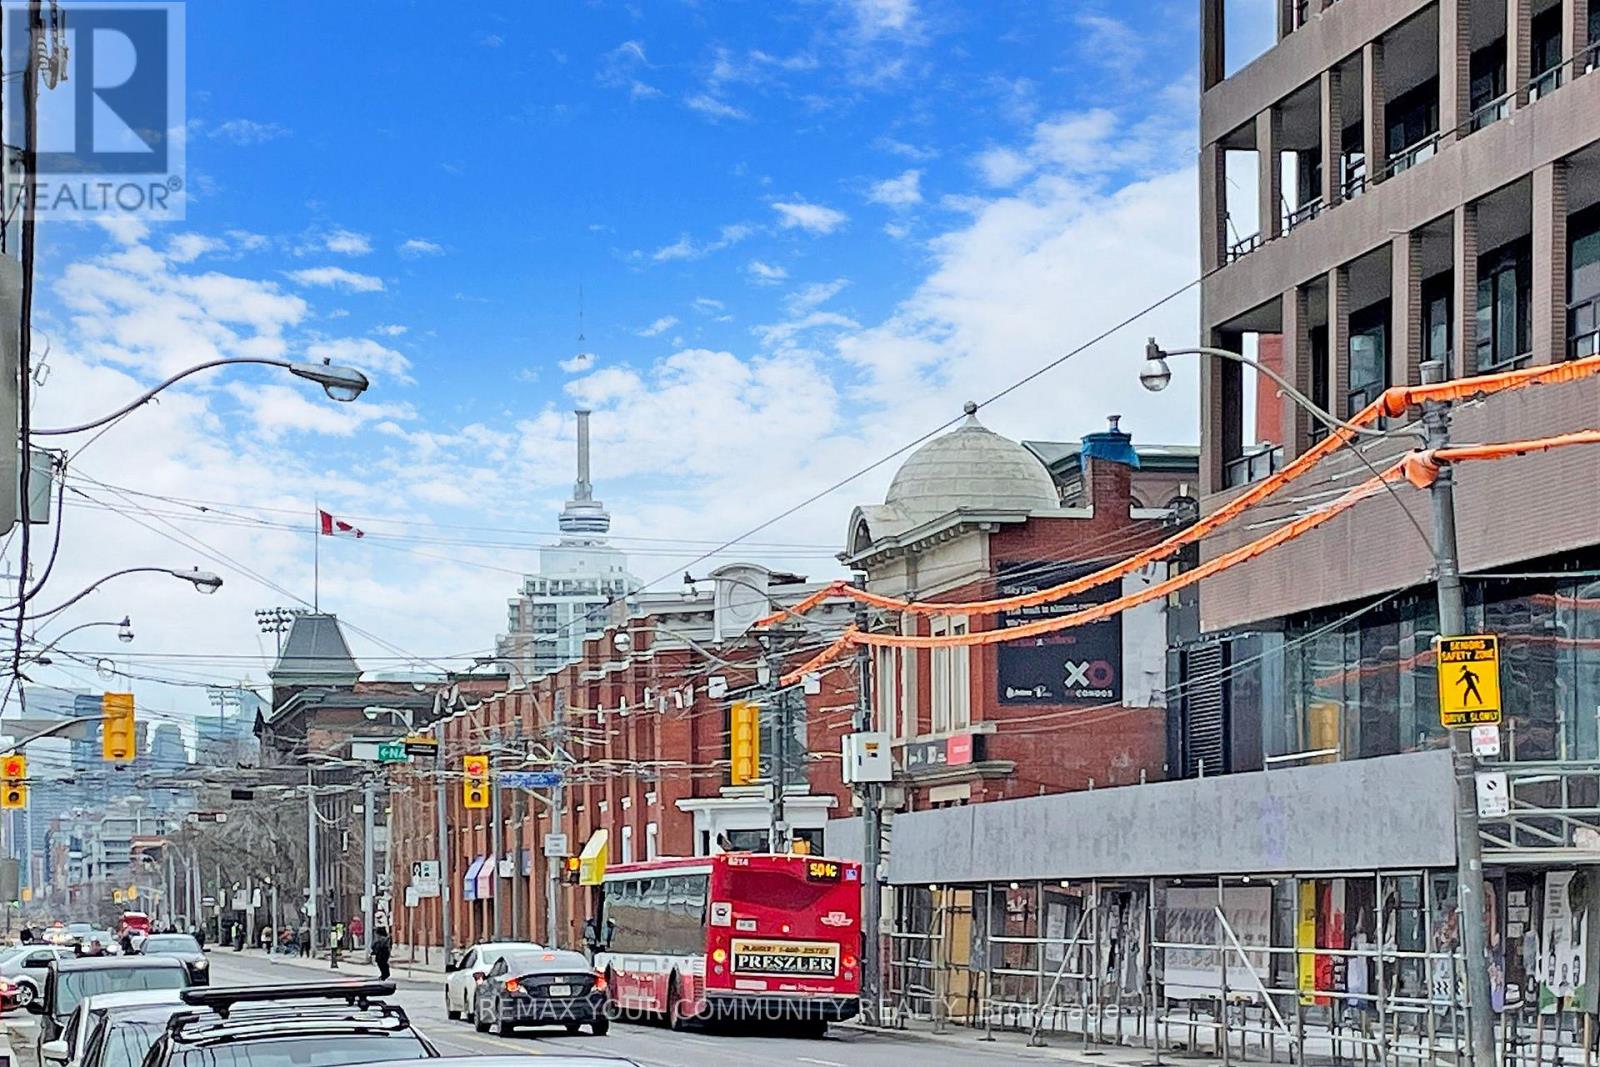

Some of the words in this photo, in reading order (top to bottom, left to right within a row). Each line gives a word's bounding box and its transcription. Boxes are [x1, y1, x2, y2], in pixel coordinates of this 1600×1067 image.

[1441, 651, 1472, 661] SAFETY
[1064, 660, 1114, 688] XO
[737, 954, 833, 970] PRESZLER
